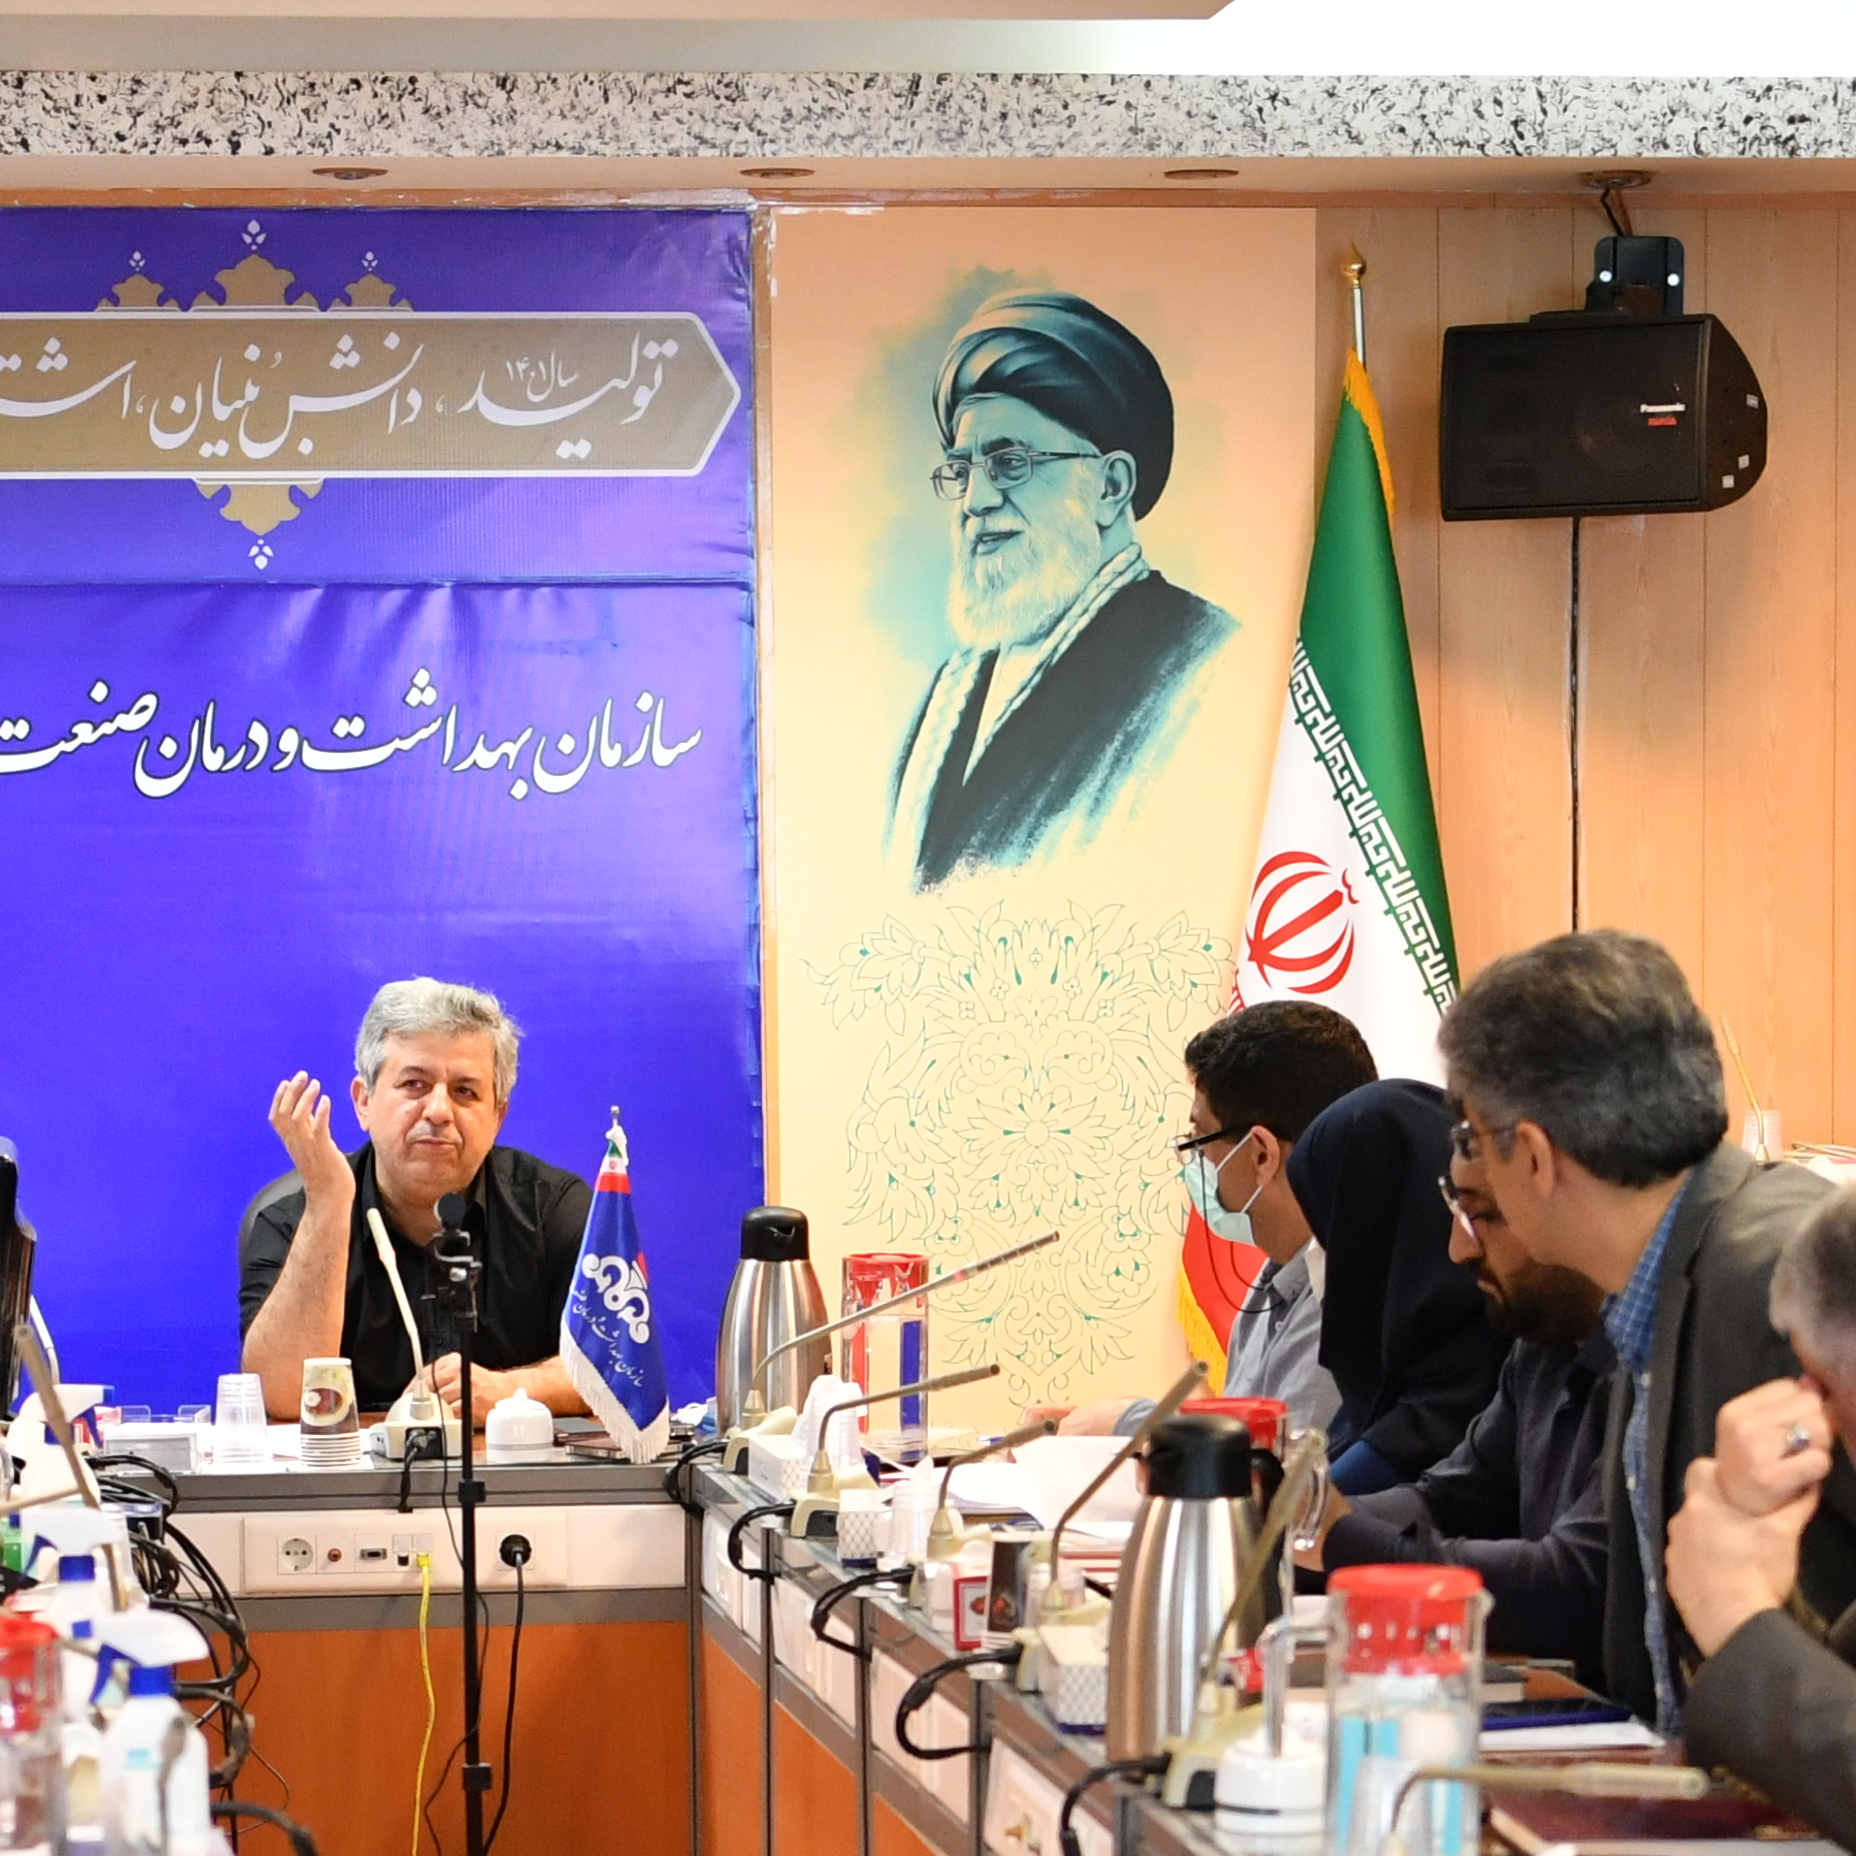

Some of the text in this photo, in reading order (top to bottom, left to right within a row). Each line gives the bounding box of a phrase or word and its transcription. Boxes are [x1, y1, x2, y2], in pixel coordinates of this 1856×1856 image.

[132, 699, 270, 799] درمان
[271, 725, 300, 773] و
[300, 667, 534, 801] بهداشت
[532, 690, 703, 794] سازمان
